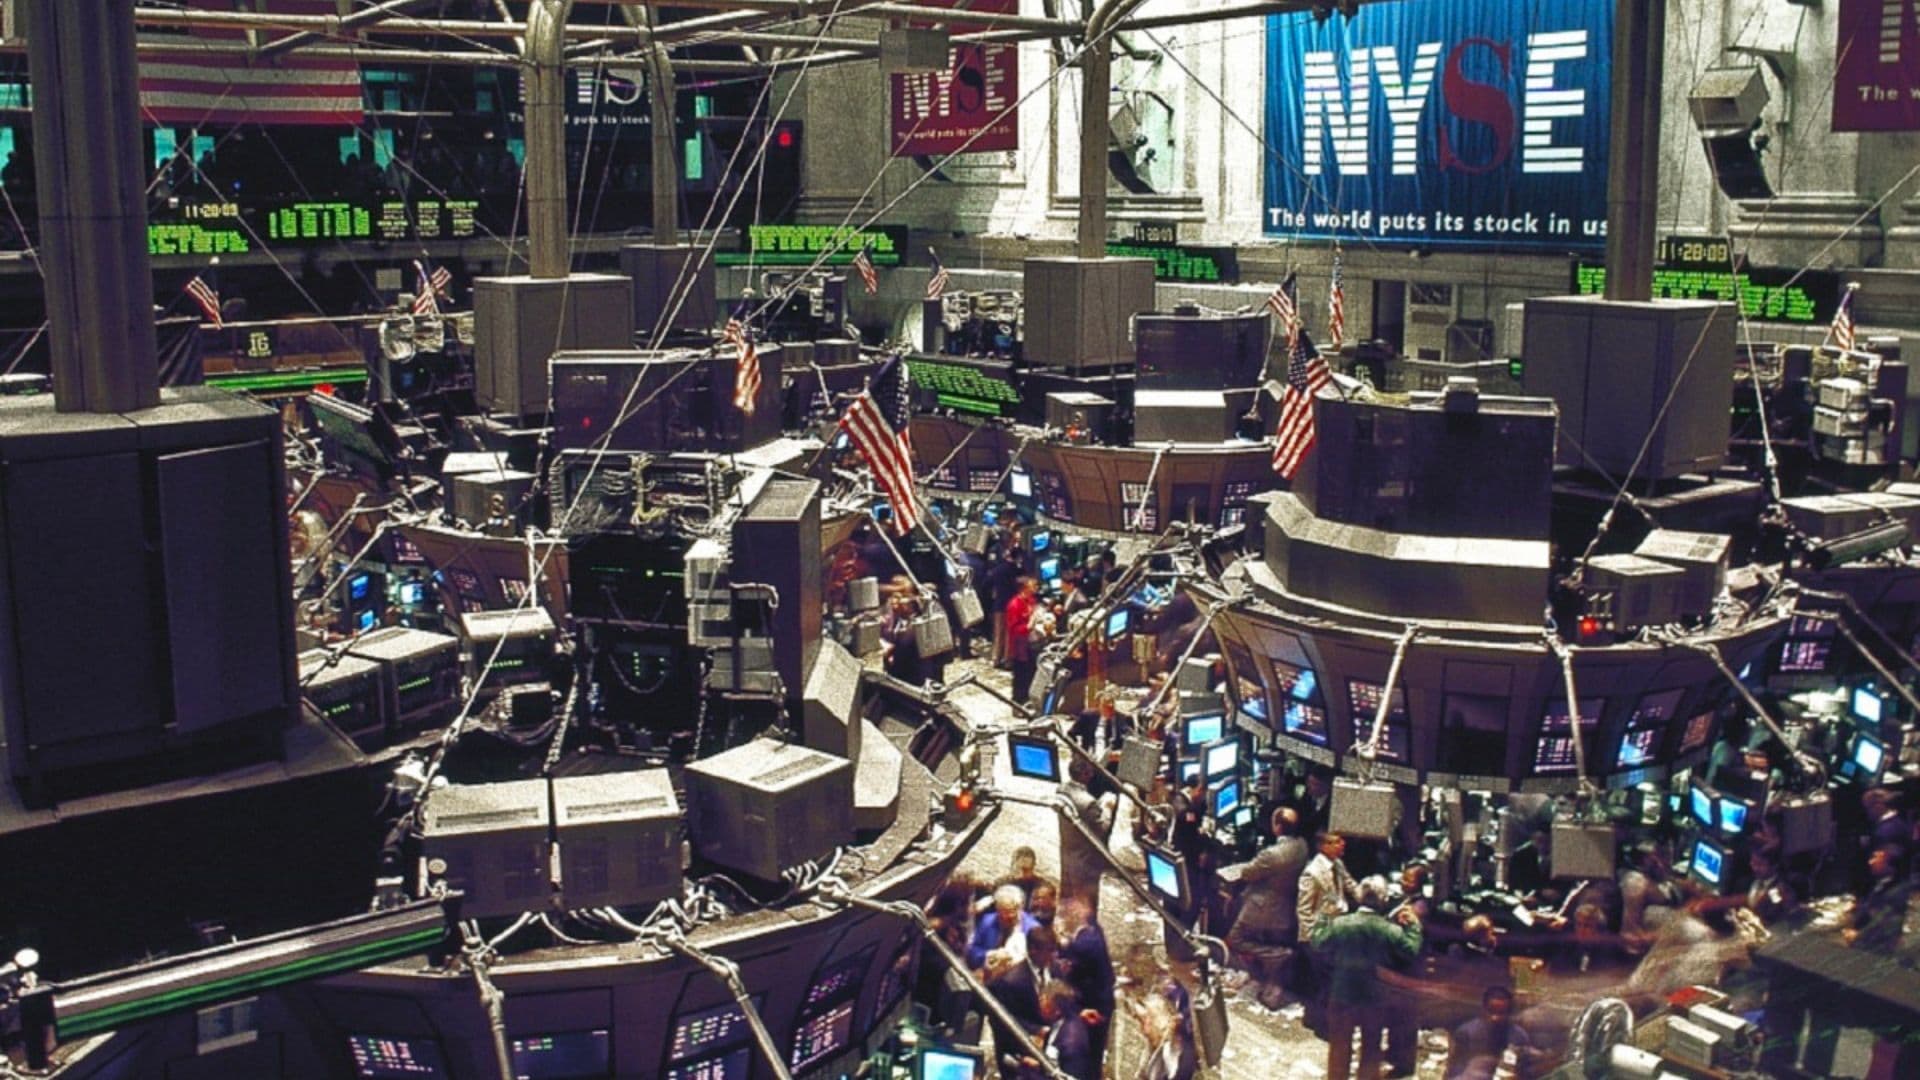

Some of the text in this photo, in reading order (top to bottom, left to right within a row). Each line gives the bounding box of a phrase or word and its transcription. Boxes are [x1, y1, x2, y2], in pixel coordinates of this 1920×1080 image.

[1303, 30, 1587, 176] NYSE
[1858, 85, 1899, 101] The
[1269, 207, 1609, 236] The world puts its stock in us
